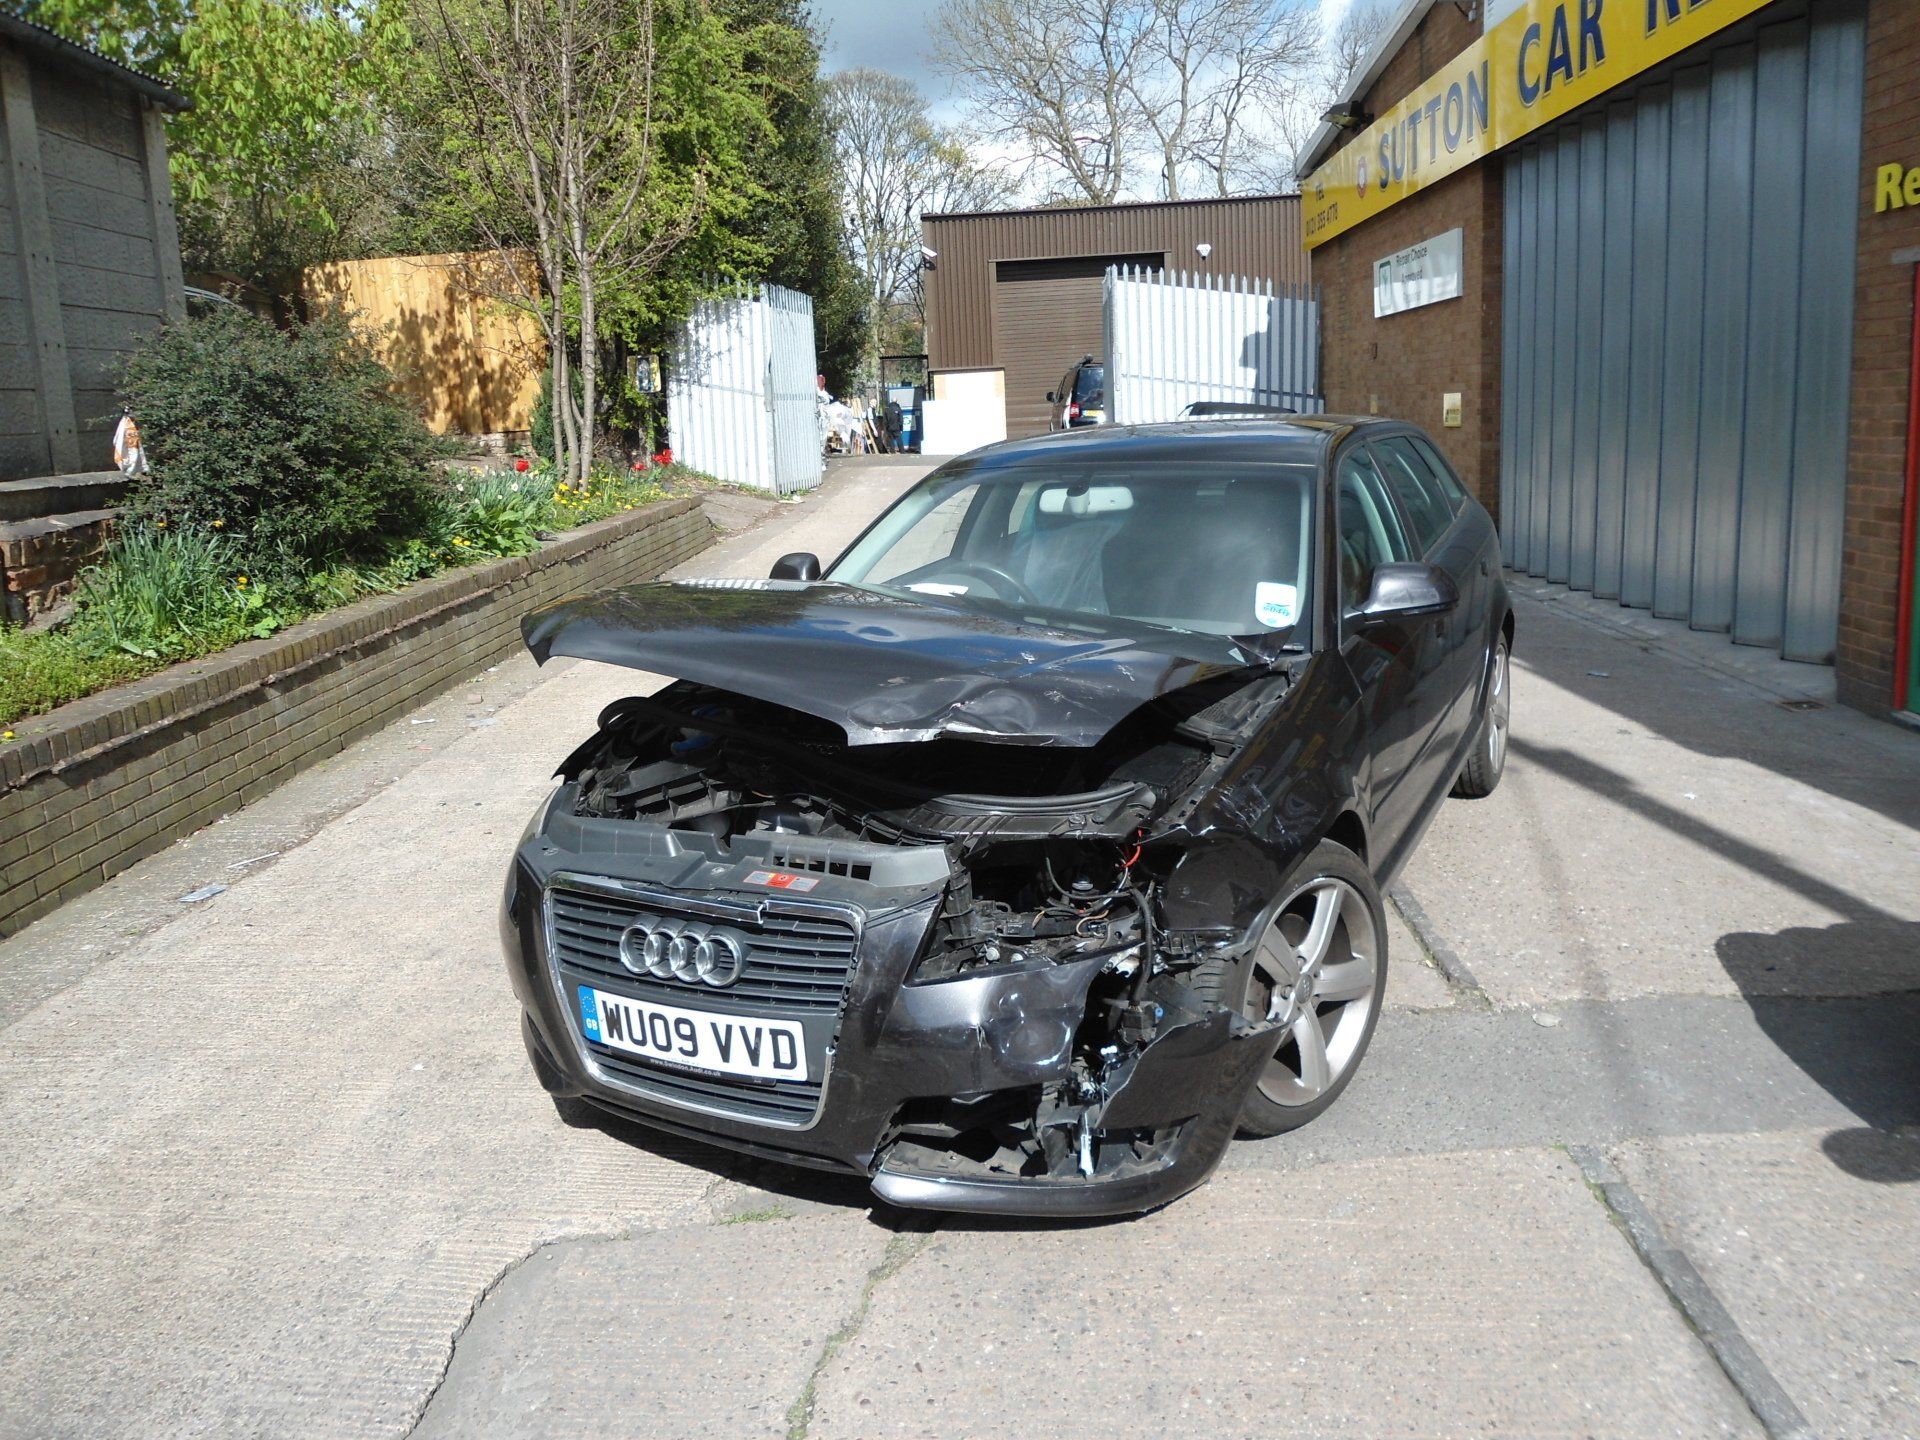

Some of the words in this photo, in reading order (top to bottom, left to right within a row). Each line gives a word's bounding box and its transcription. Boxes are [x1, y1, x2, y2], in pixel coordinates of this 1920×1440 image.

[1378, 59, 1488, 192] SUTTON
[1517, 0, 1606, 109] CAR
[585, 1017, 599, 1031] GB
[601, 999, 699, 1058] WU09
[710, 1021, 798, 1071] VVD
